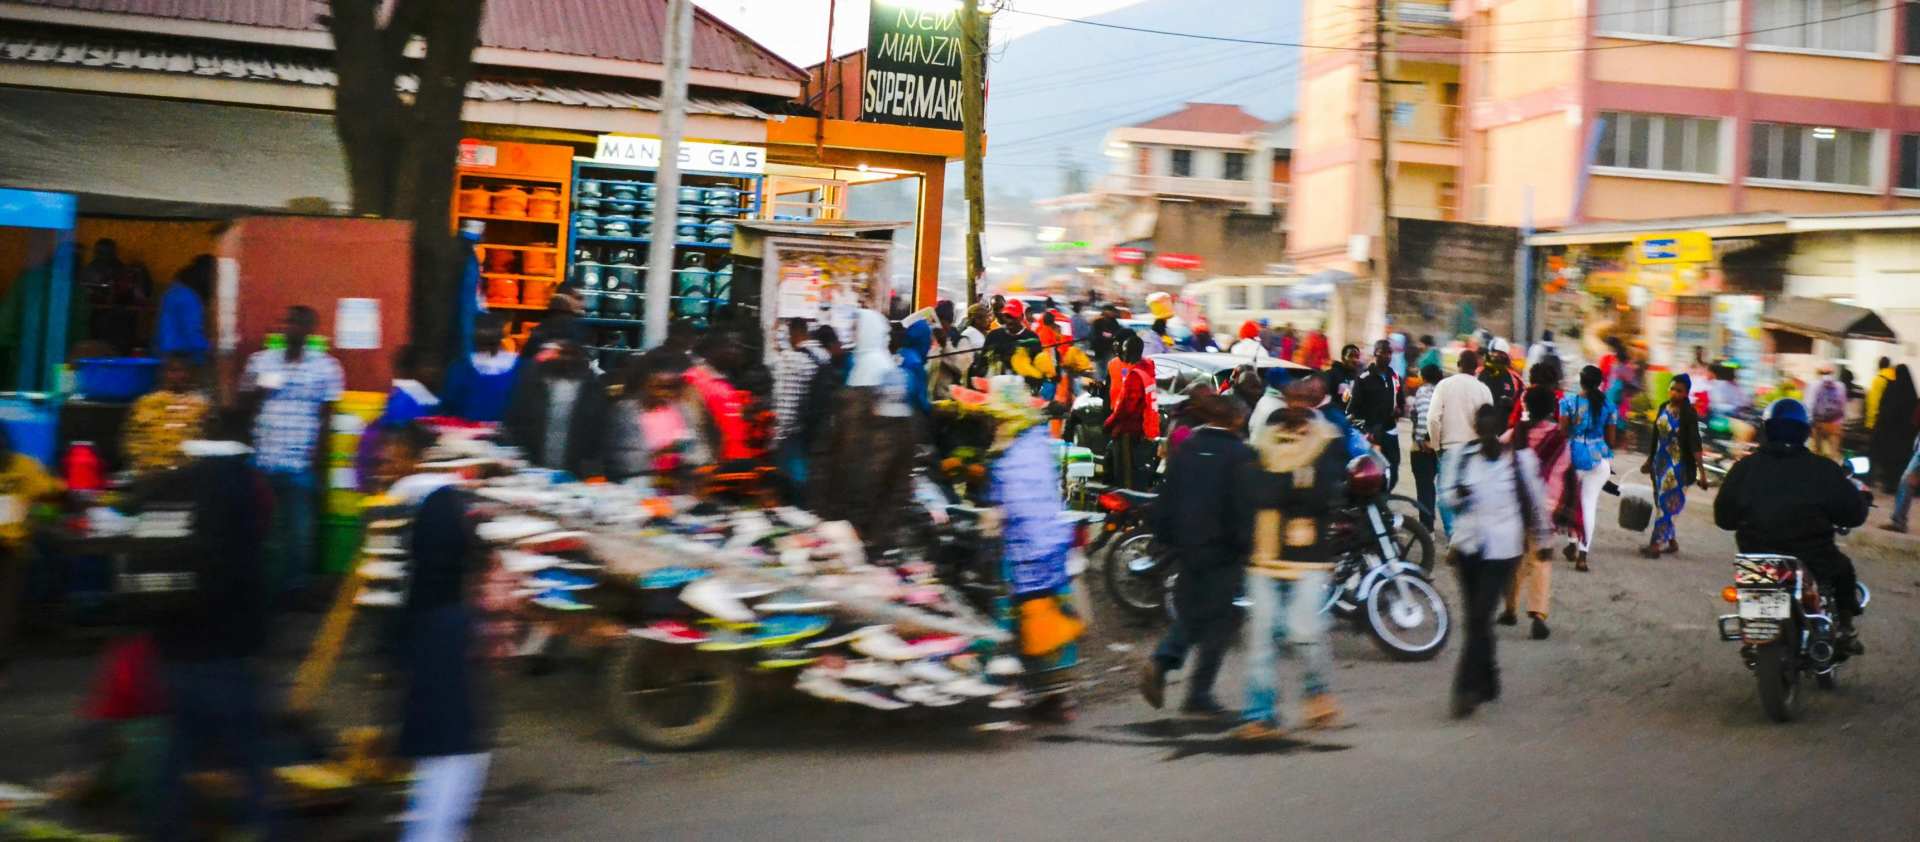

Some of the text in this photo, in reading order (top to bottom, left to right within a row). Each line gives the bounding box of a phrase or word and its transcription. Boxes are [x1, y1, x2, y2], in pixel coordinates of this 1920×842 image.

[896, 7, 958, 31] NEW
[877, 32, 964, 67] MIANZIN
[864, 69, 985, 122] SUPERMARK
[602, 142, 758, 168] MANS GAS
